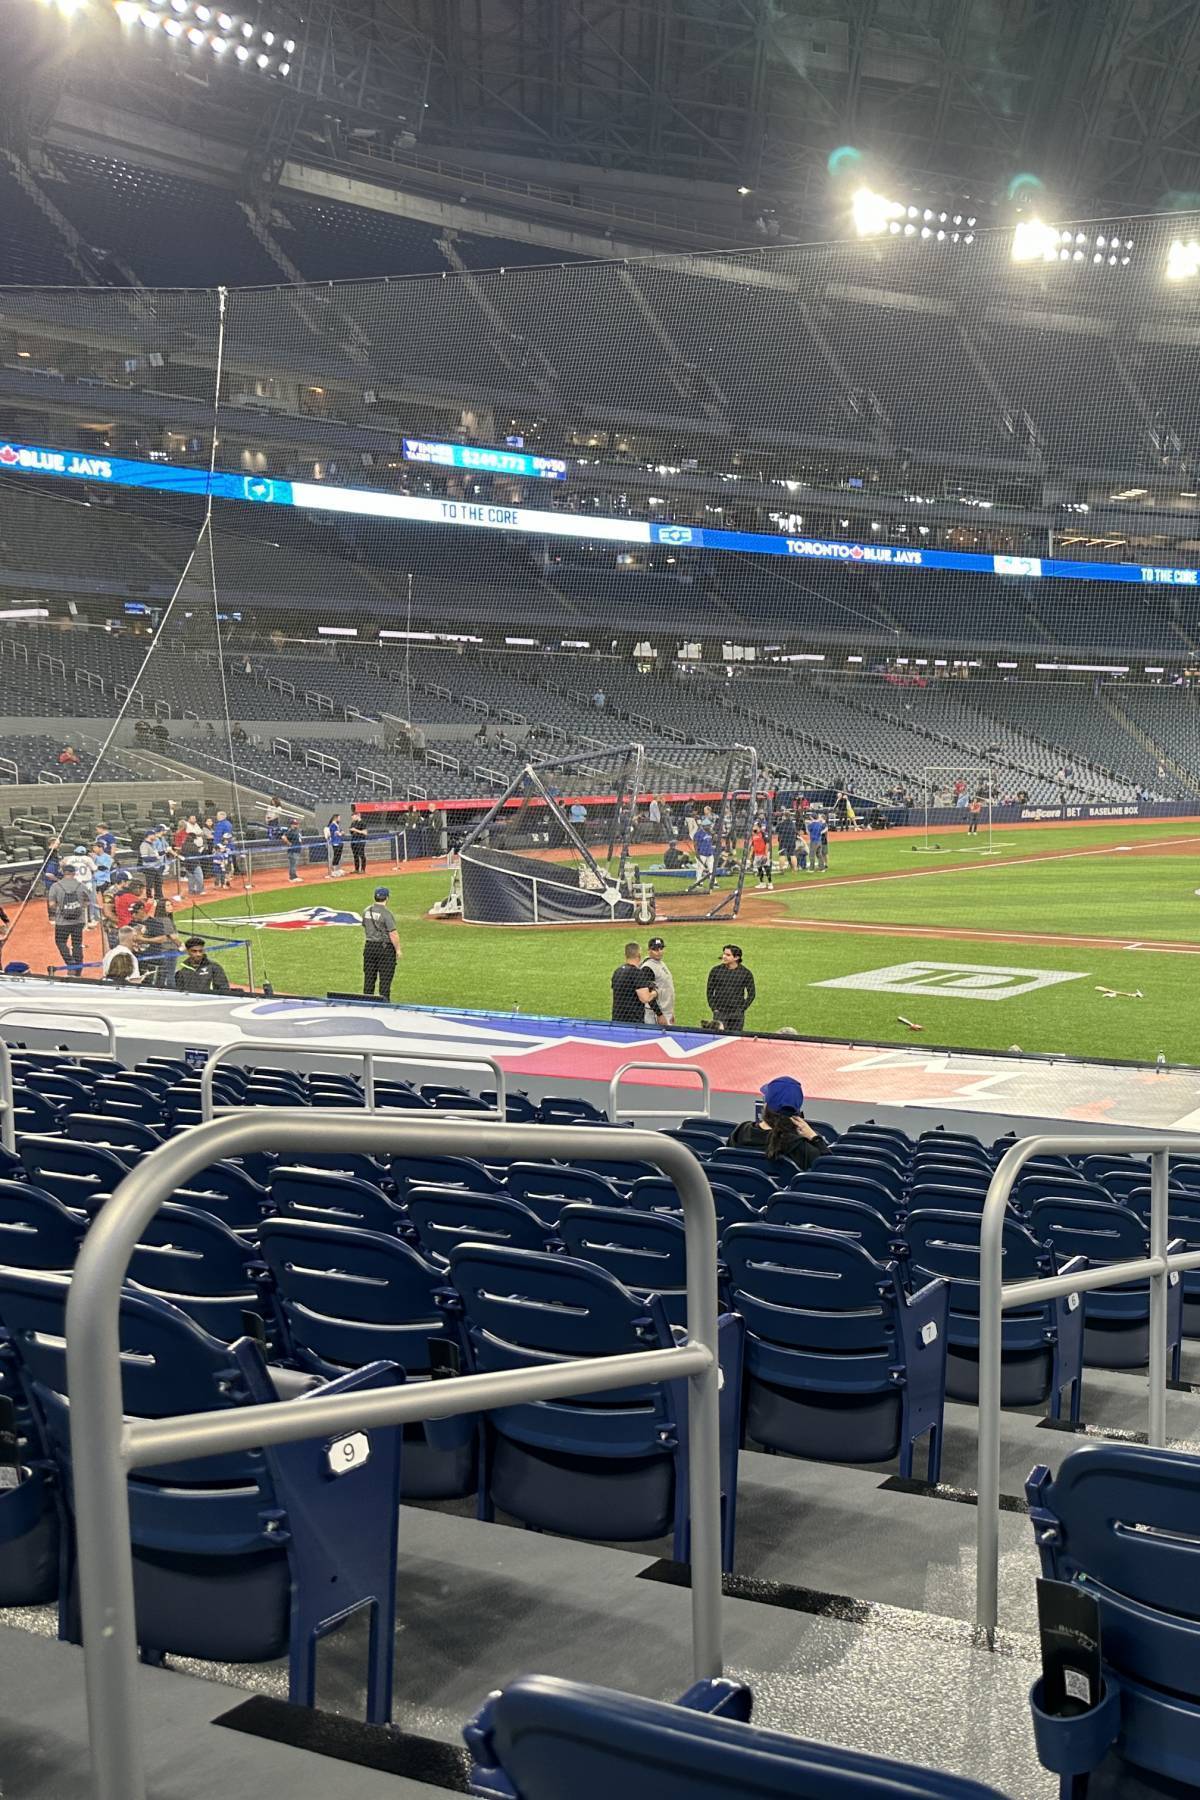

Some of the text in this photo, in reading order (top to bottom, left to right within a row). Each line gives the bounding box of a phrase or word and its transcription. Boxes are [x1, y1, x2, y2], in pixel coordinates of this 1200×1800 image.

[19, 449, 112, 478] BLUE JAYS
[441, 503, 519, 525] TO THE CORE
[786, 540, 922, 564] TORONTO BLUE JAYS
[1141, 567, 1198, 584] TO THE CORE
[1021, 807, 1082, 819] theScore BET
[1089, 806, 1139, 816] BASELINE BOX
[343, 1443, 355, 1462] 9
